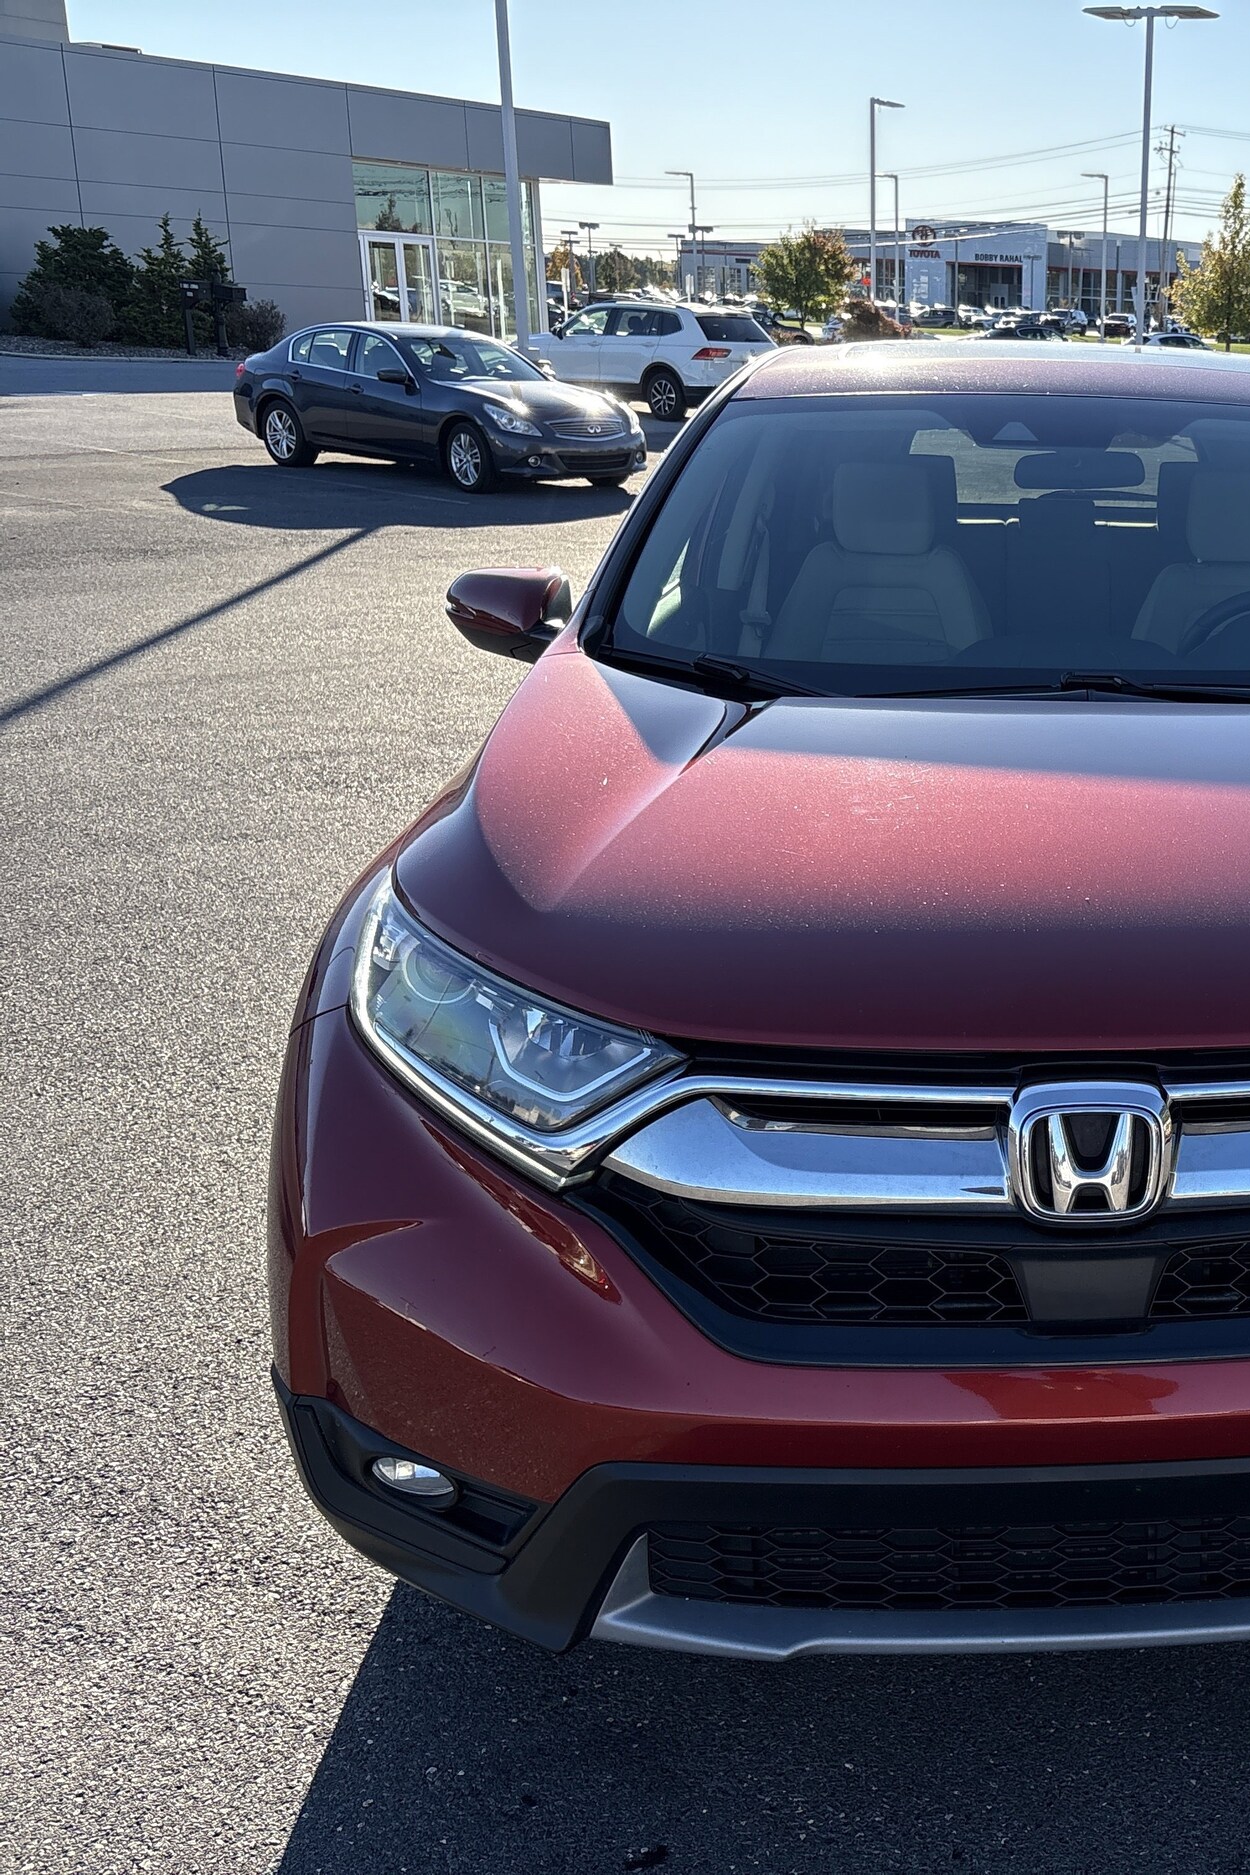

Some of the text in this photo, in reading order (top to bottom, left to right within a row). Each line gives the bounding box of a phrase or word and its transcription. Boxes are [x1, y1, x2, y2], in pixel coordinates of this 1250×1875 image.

[908, 249, 941, 259] TOYOTA
[974, 253, 1023, 263] BOBBY RAHAL
